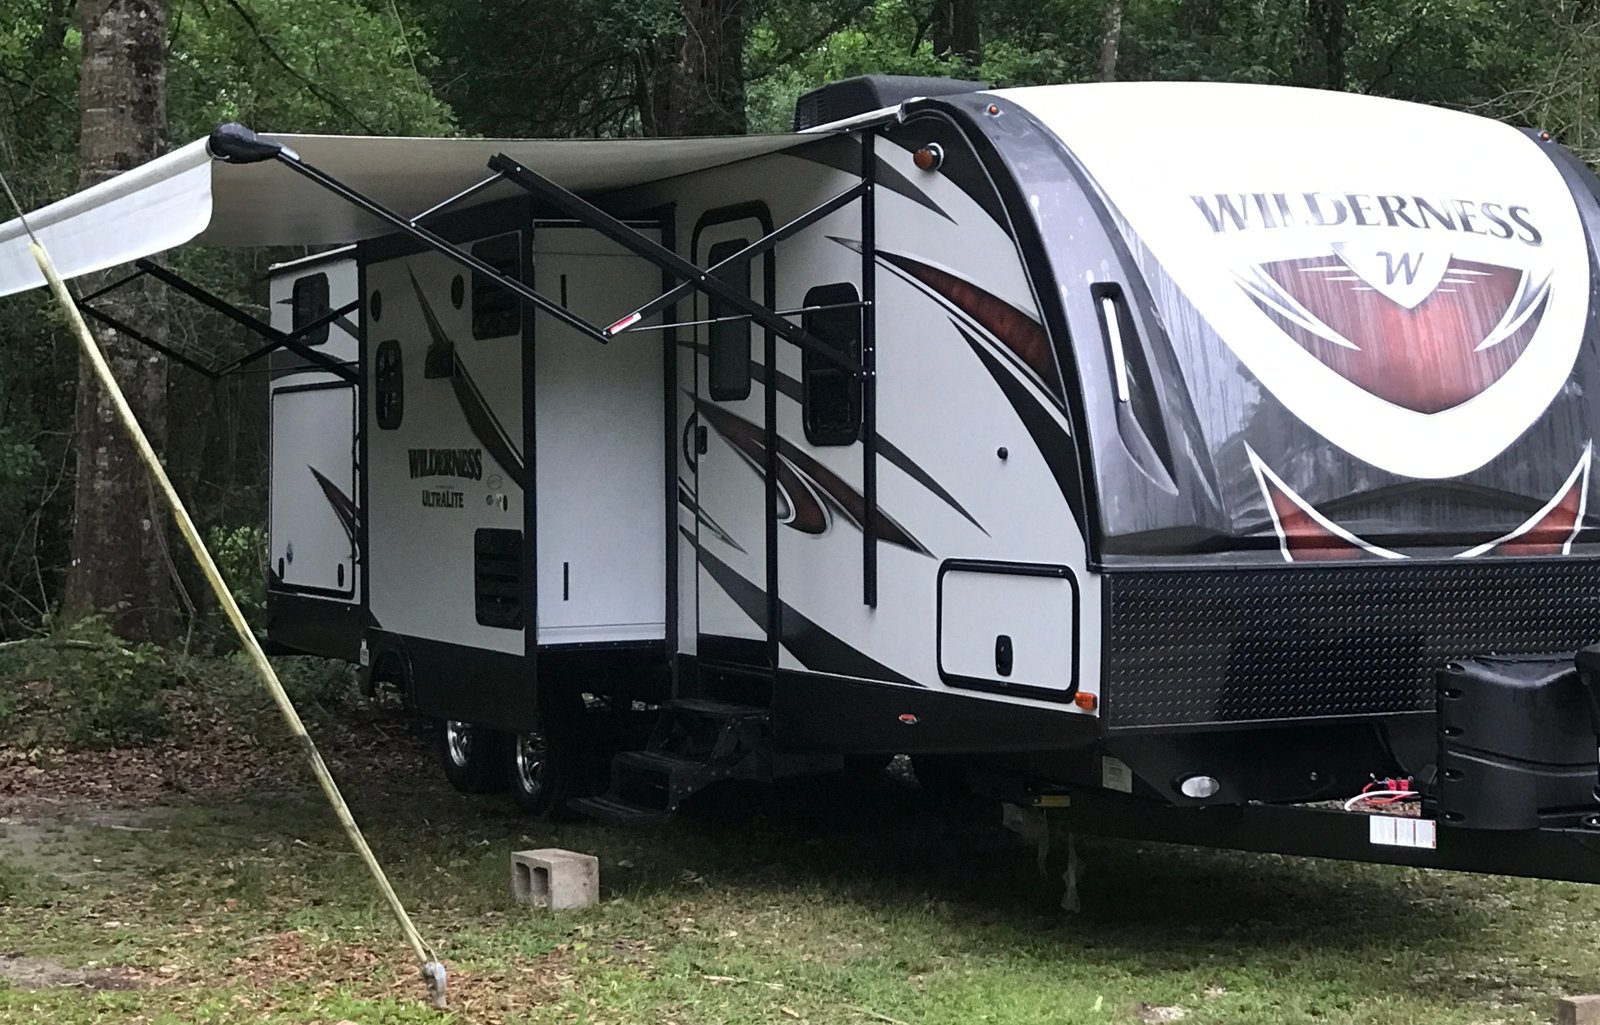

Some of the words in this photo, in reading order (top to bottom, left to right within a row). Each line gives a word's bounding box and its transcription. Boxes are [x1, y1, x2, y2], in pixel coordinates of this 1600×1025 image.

[1190, 192, 1543, 246] WILDERNESS
[1376, 251, 1424, 285] W
[408, 448, 482, 481] WILDERNESS
